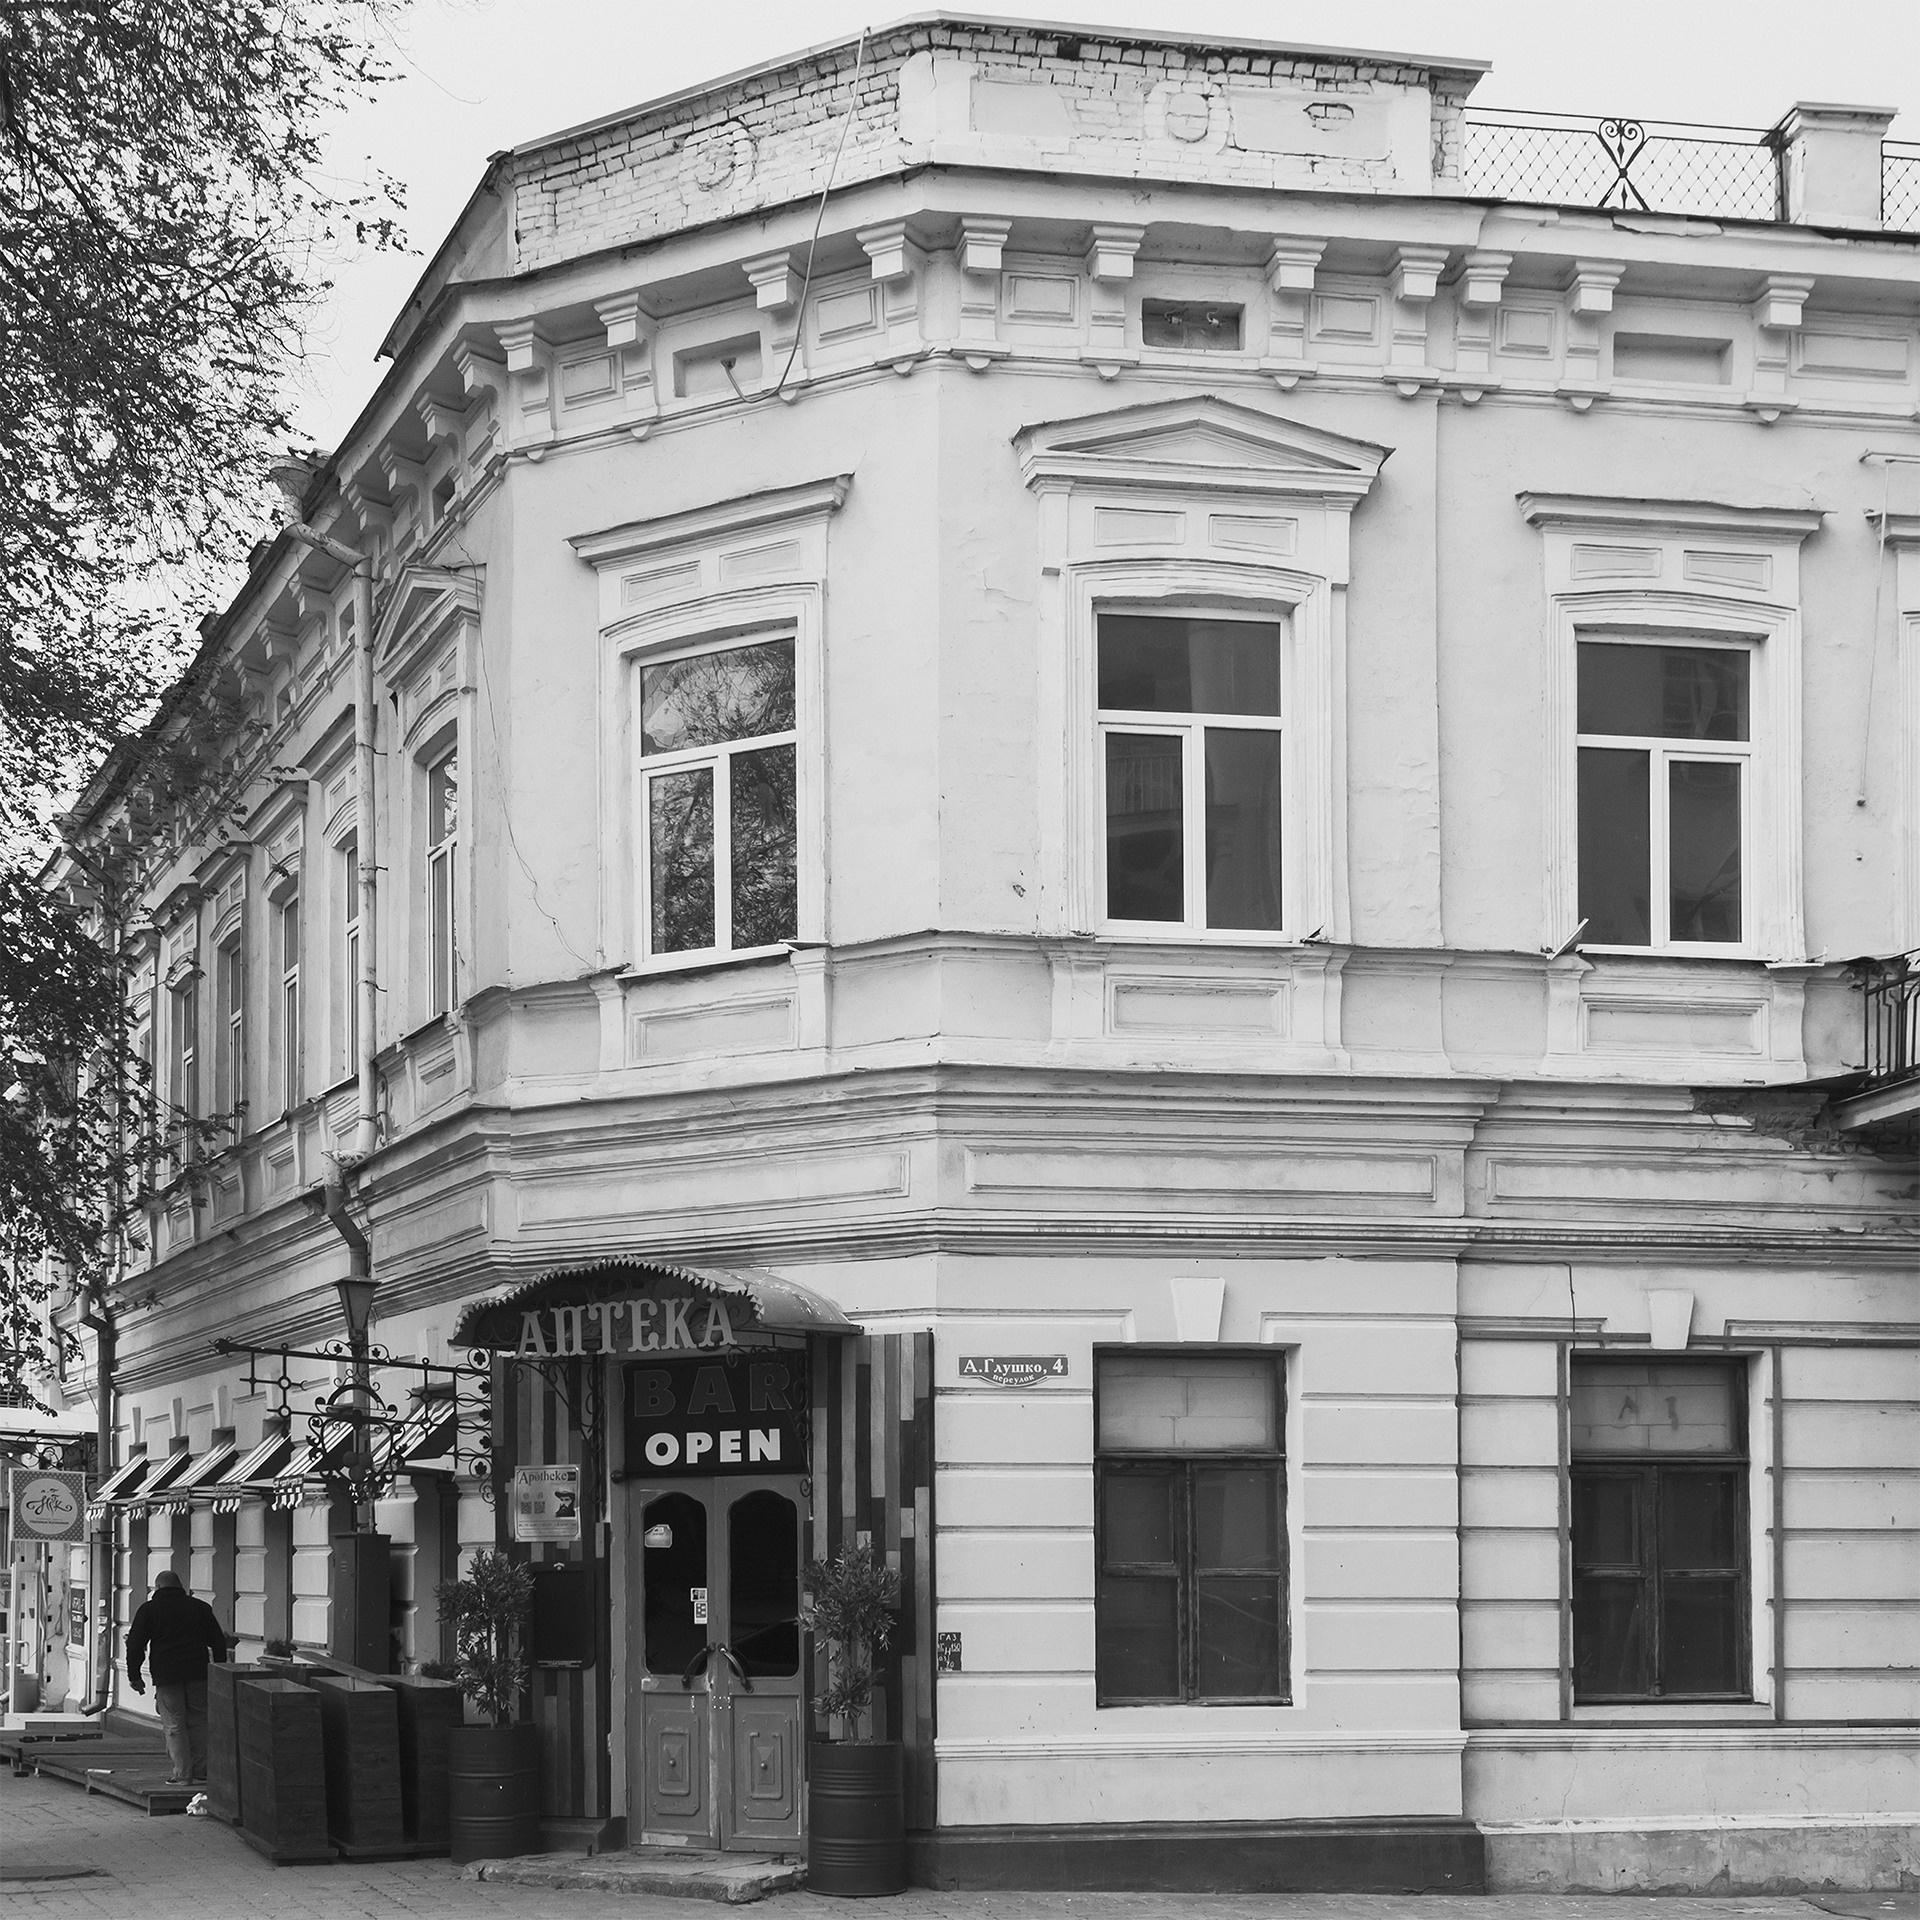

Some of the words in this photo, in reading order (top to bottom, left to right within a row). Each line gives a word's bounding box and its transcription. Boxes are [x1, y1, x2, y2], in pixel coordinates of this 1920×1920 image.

[513, 1297, 738, 1359] АПТЕКА
[1052, 1358, 1064, 1373] 4
[633, 1363, 794, 1418] BAR
[992, 1374, 1035, 1385] переулок
[644, 1428, 782, 1466] OPEN
[518, 1470, 568, 1486] Apotheke
